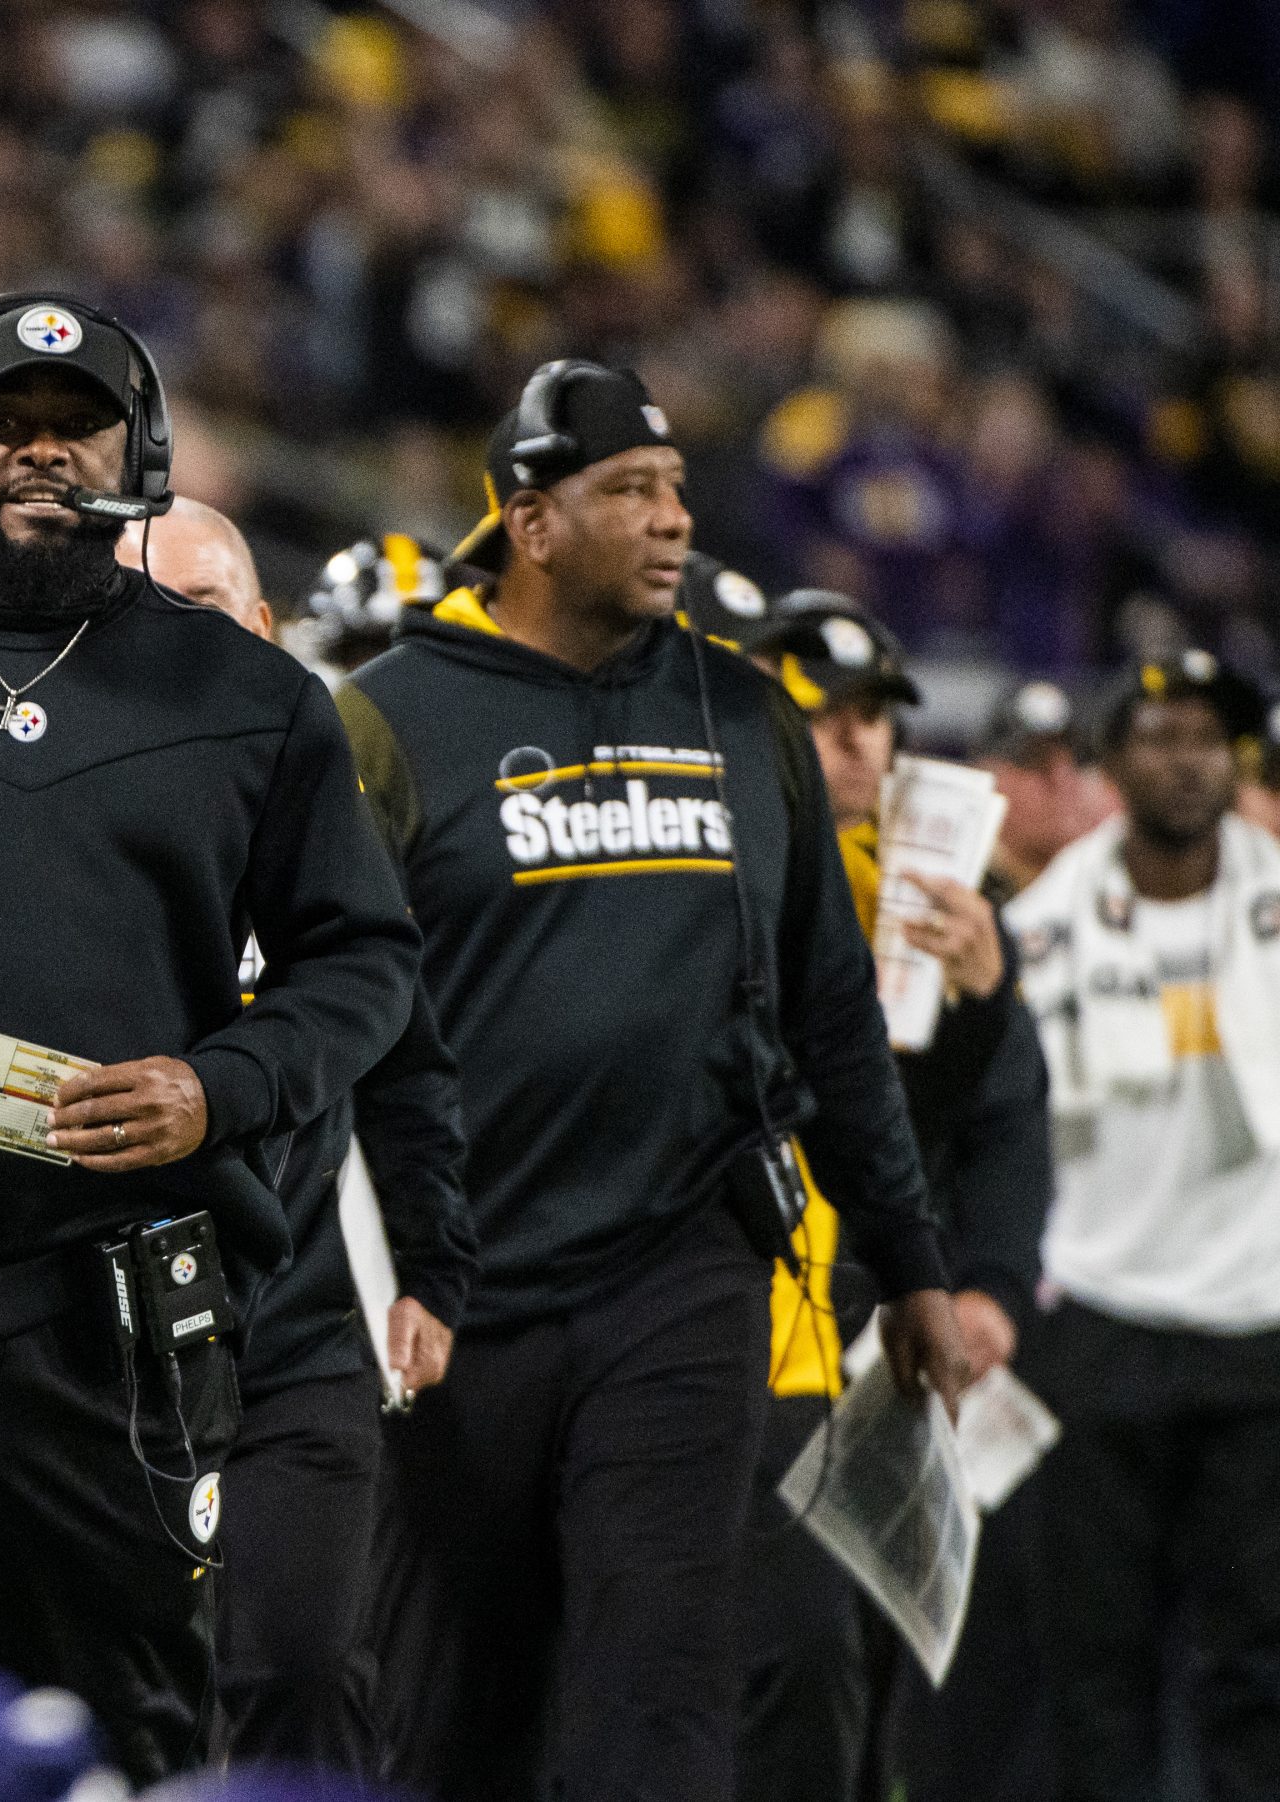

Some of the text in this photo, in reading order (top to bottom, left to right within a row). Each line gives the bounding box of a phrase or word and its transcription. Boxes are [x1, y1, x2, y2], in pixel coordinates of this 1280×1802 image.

[81, 498, 146, 516] BOSE
[499, 779, 732, 865] Steelers
[112, 1258, 133, 1334] BOSE
[175, 1312, 211, 1333] PHELPS
